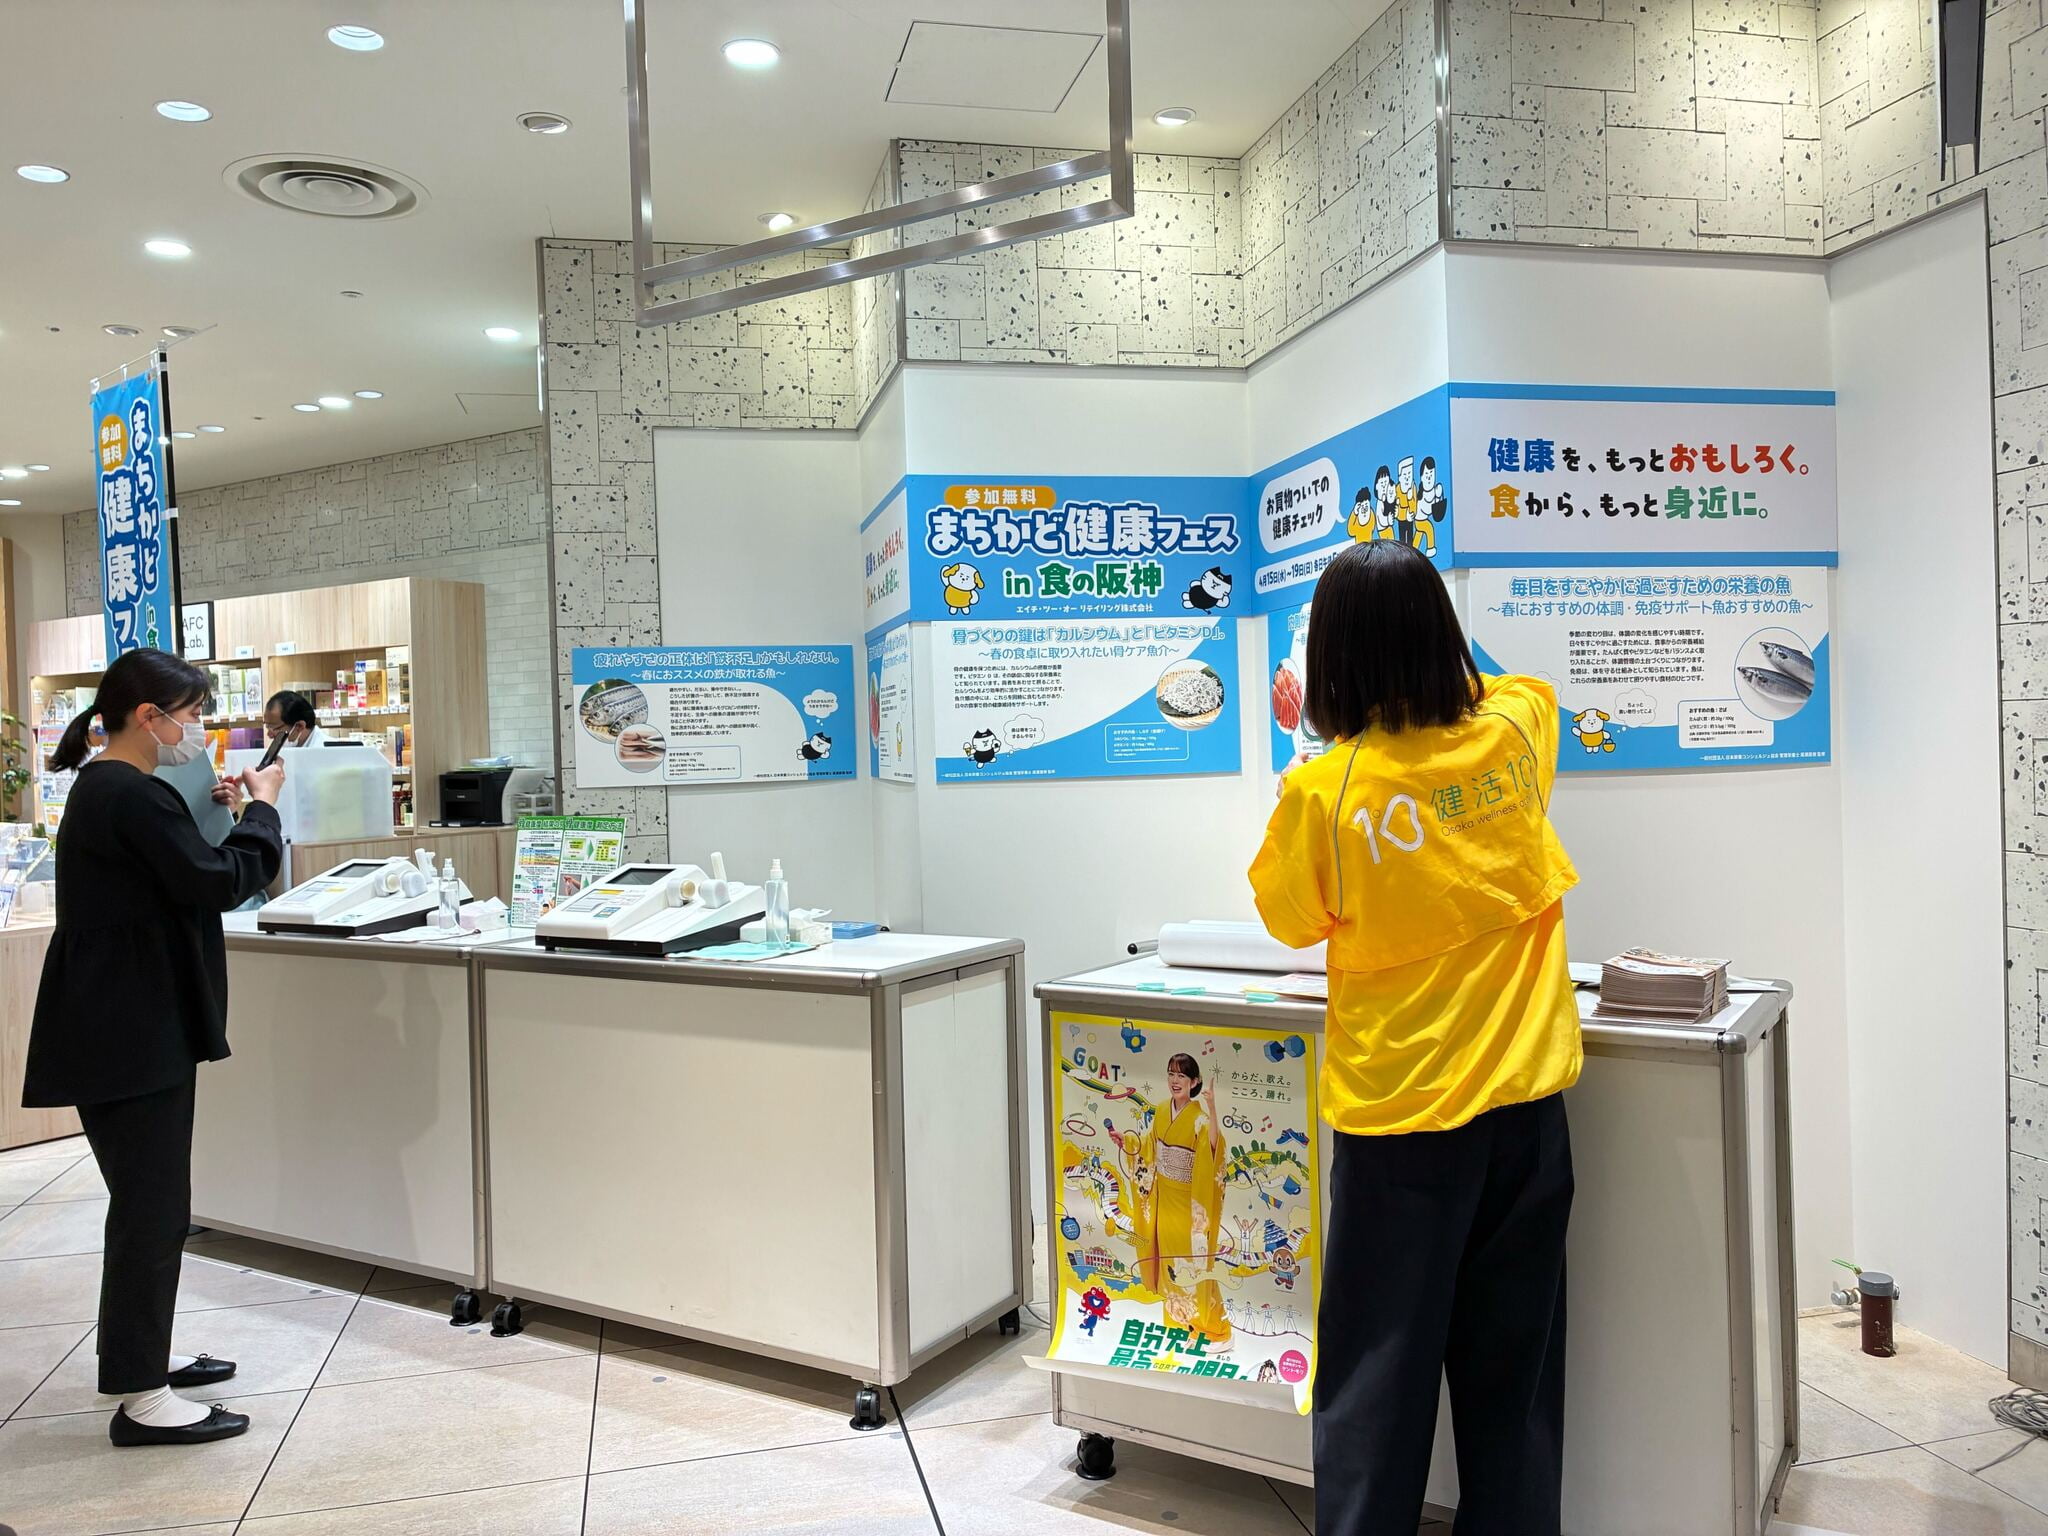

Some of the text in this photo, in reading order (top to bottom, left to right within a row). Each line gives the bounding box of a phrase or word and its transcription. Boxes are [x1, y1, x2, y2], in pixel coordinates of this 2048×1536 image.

[102, 423, 121, 445] 参加
[102, 443, 122, 466] 無料
[1488, 437, 1809, 475] 健康を、もっとおもしろく。
[132, 404, 158, 587] まちかど
[964, 489, 1037, 505] 参加無料
[1266, 476, 1329, 516] お買物ついでの
[1488, 484, 1768, 519] 食から、もっと身近に。
[929, 503, 1238, 553] まちかど健康フェス
[1272, 504, 1323, 541] 健康チェック
[102, 475, 140, 655] 健康フ
[1005, 562, 1162, 597] in 食の阪神
[1510, 575, 1791, 597] 毎日をすこやかに過ごすための栄養の魚
[182, 616, 204, 632] AFC
[1079, 603, 1154, 613] リテイリング株式会社
[952, 625, 1226, 645] 骨づくりの鍵は「カルシウム」と「ビタミンD」。
[593, 651, 840, 668] 疲れやすさの正体は「鉄不足」かもしれない。
[1441, 802, 1518, 837] Osaka wellness
[1073, 1046, 1121, 1082] GOAT
[1231, 1071, 1291, 1086] からだ、歌え。
[1231, 1086, 1292, 1102] こころ、踊れ。
[1120, 1319, 1212, 1357] 自分史上
